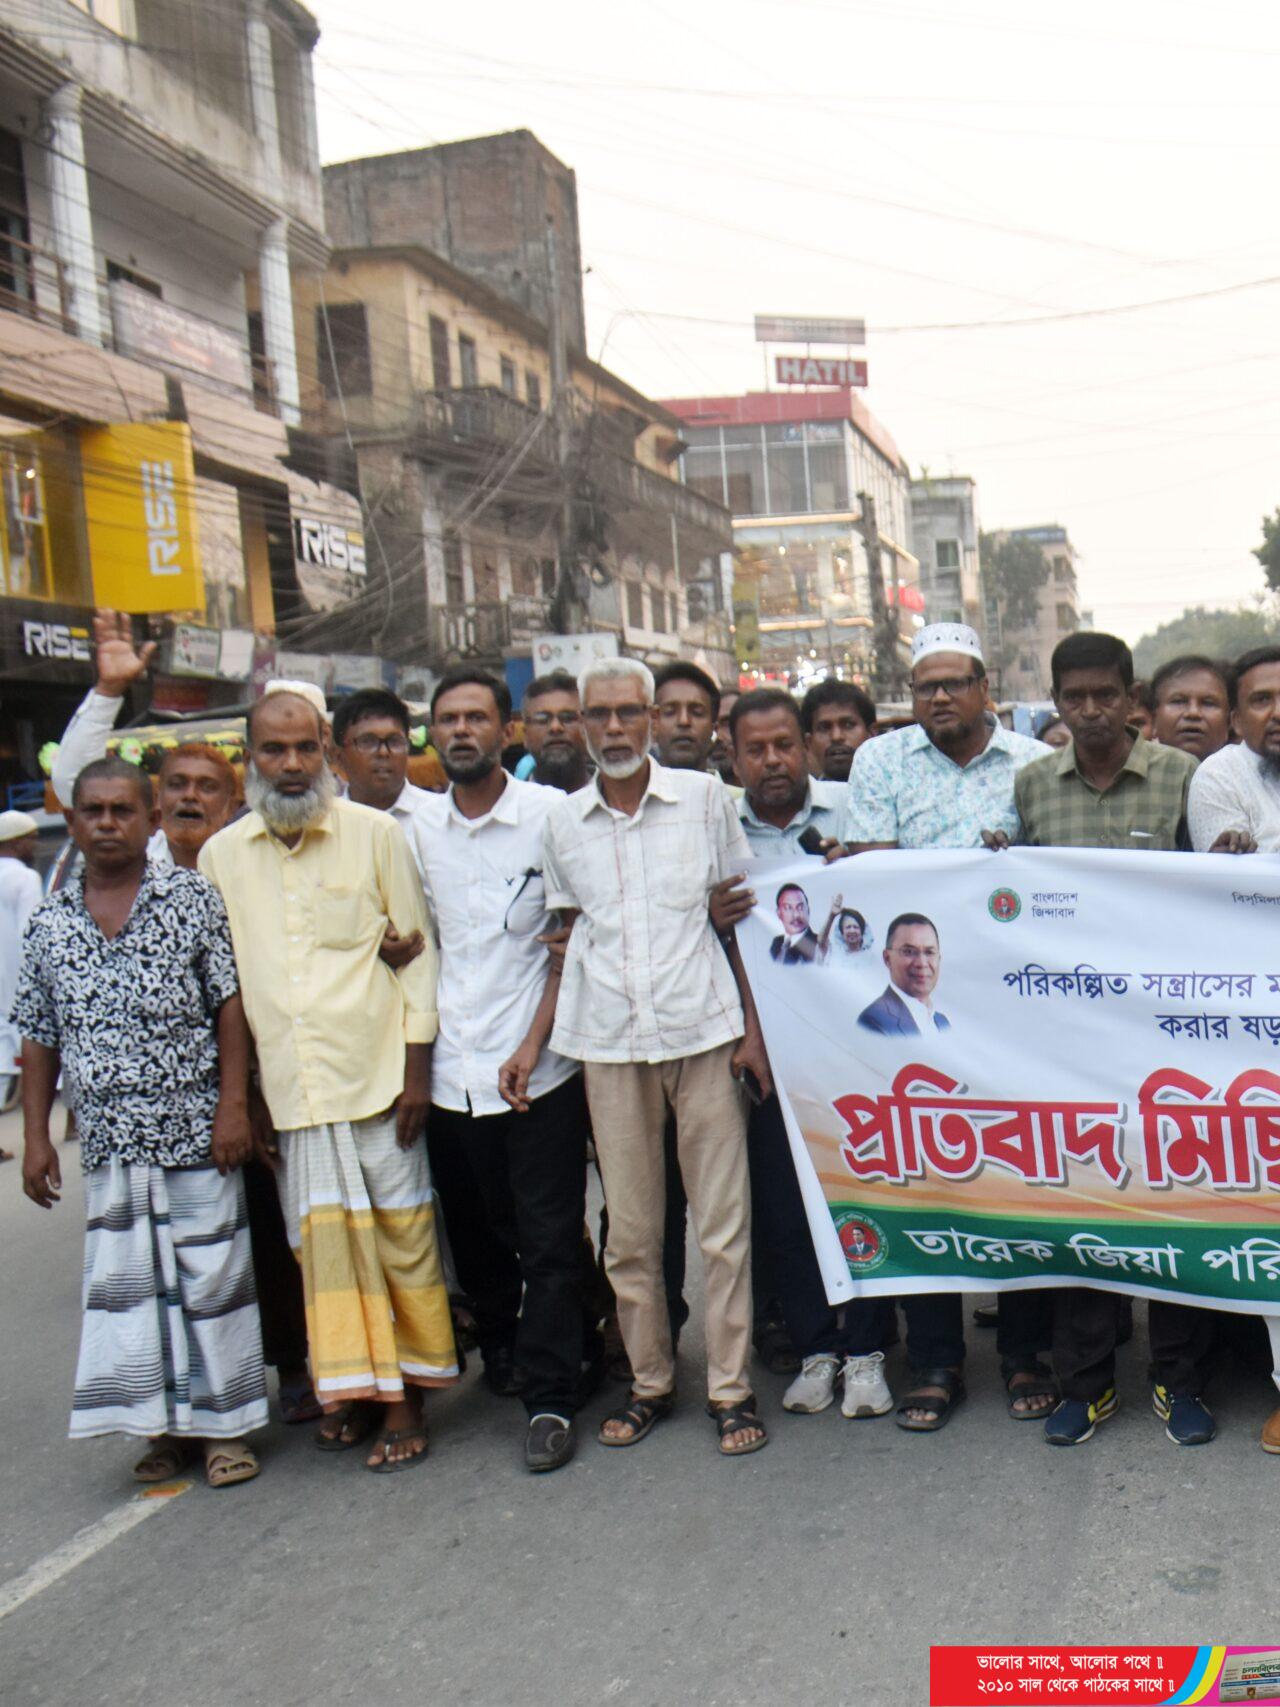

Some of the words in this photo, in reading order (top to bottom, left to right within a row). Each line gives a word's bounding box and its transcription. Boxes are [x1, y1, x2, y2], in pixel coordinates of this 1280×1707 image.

[781, 358, 865, 385] HATIL
[141, 459, 182, 577] RISE
[300, 518, 367, 577] RISE
[22, 620, 92, 662] RISE
[1031, 891, 1079, 905] বাংলাদেশ
[1032, 905, 1076, 919] জিন্দাবাদ
[1003, 963, 1132, 999] পরিকল্পিত
[1140, 970, 1256, 1000] সন্ত্রাসের
[1154, 1011, 1232, 1042] করার
[831, 1062, 1128, 1186] প্রতিবাদ
[901, 1225, 1057, 1265] তারেক
[1064, 1232, 1186, 1280] জিয়া
